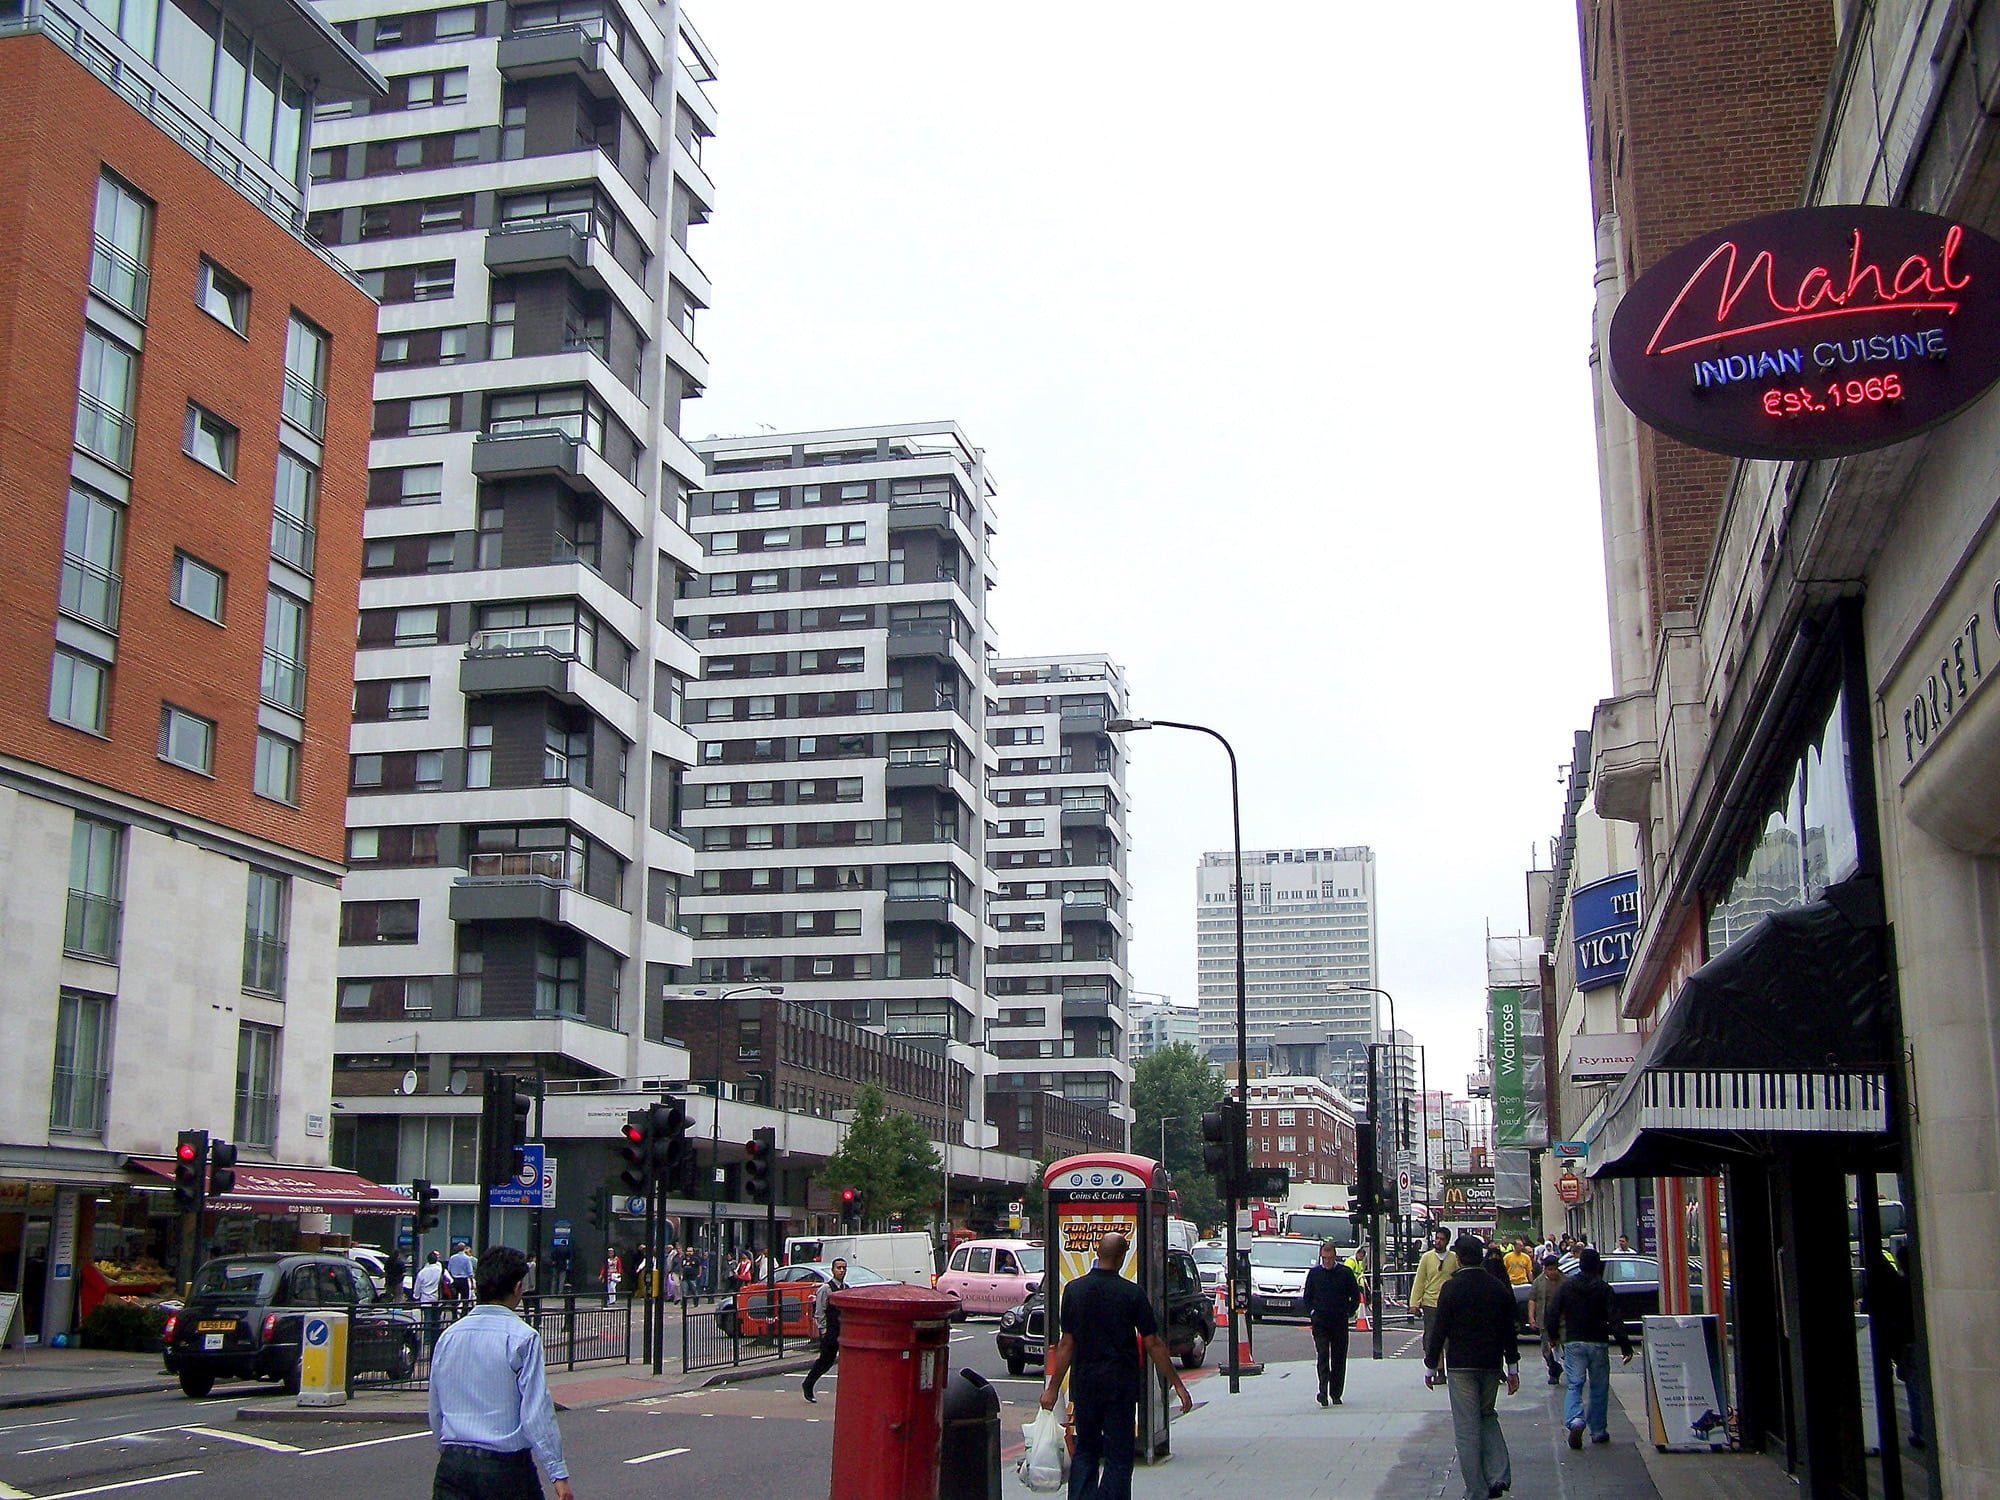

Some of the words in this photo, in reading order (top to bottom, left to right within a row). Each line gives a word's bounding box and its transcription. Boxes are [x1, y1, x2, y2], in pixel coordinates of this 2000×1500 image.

[1645, 224, 1972, 357] Mahal
[1693, 347, 1801, 388] INDIAN
[1812, 328, 1949, 372] CUISINE
[1829, 374, 1902, 409] 1965
[1903, 613, 1980, 763] FORSET
[1610, 891, 1638, 915] TH
[1500, 1004, 1516, 1076] Waitrose
[1578, 1056, 1636, 1065] Ryman
[1499, 1096, 1521, 1104] Open
[1500, 1117, 1521, 1126] usual
[1069, 1191, 1091, 1200] Coins
[1092, 1191, 1100, 1200] &
[1101, 1191, 1125, 1200] Cards
[1467, 1188, 1491, 1198] Open
[1064, 1224, 1087, 1232] FOR
[1089, 1223, 1132, 1232] PEOPLE
[1069, 1232, 1093, 1241] WHO
[1064, 1241, 1089, 1250] LIKE
